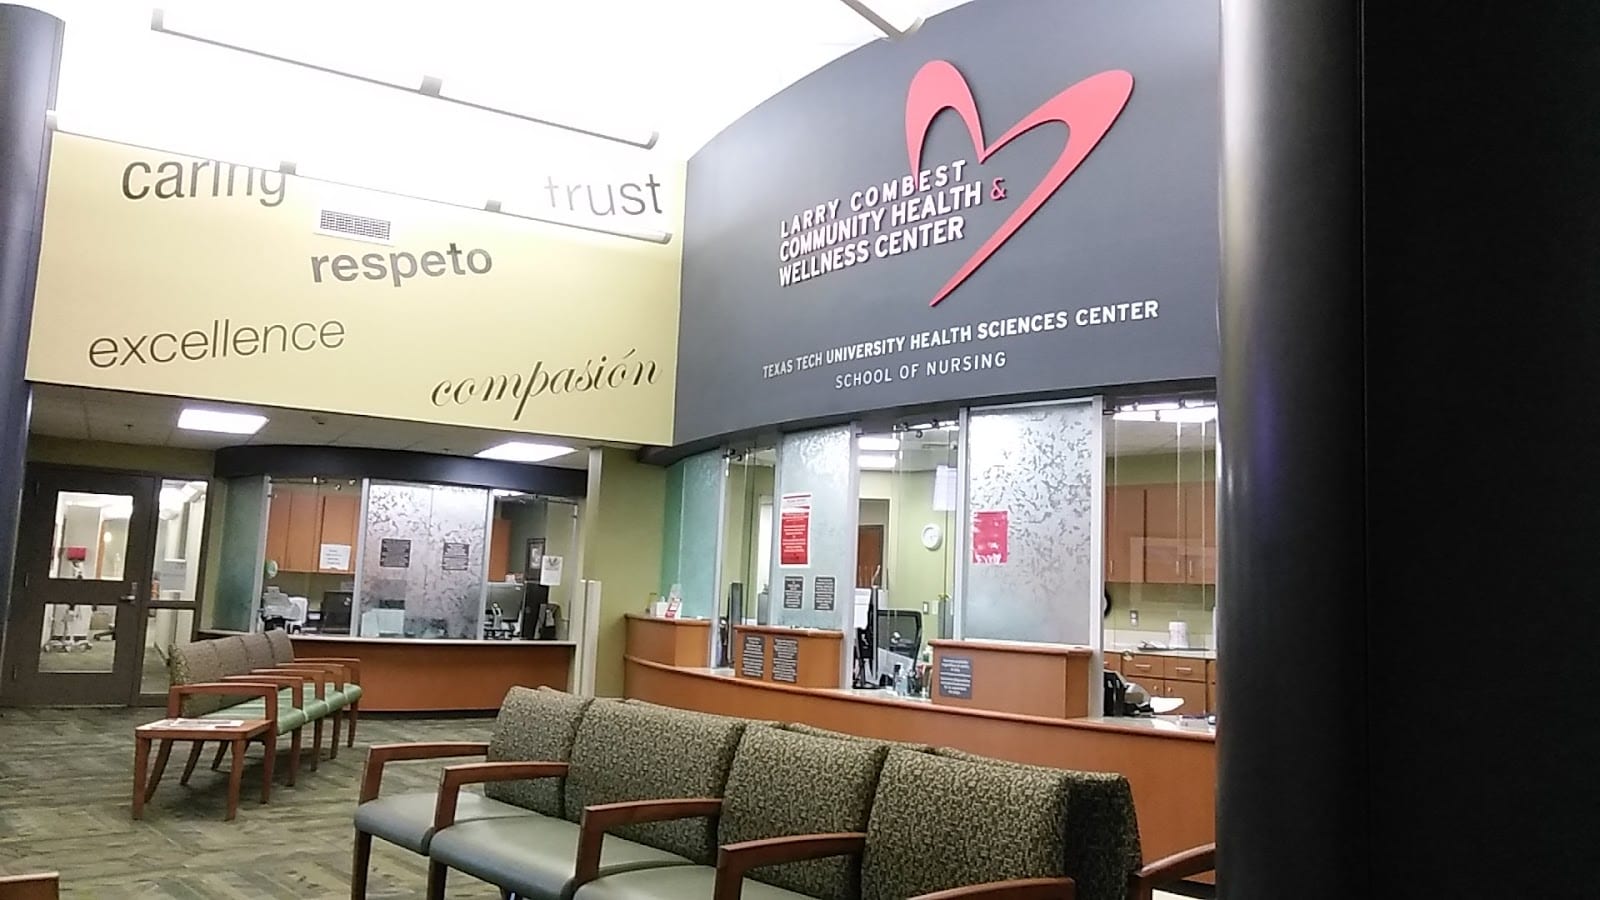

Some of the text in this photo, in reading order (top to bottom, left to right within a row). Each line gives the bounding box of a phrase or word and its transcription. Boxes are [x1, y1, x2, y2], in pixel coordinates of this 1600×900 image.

[544, 173, 663, 216] trust
[779, 177, 1007, 262] COMMUNITY HEALTH &
[780, 160, 966, 239] LARRY COMBEST
[310, 243, 493, 287] respeto
[778, 216, 965, 287] WELLNESS CENTER
[88, 316, 346, 369] excellence
[762, 299, 1160, 379] TEXAS TECH UNIVERSITY HEALTH SCIENCES CENTER
[834, 351, 1007, 389] SCHOOL OF NURSING
[431, 347, 663, 420] compasión
